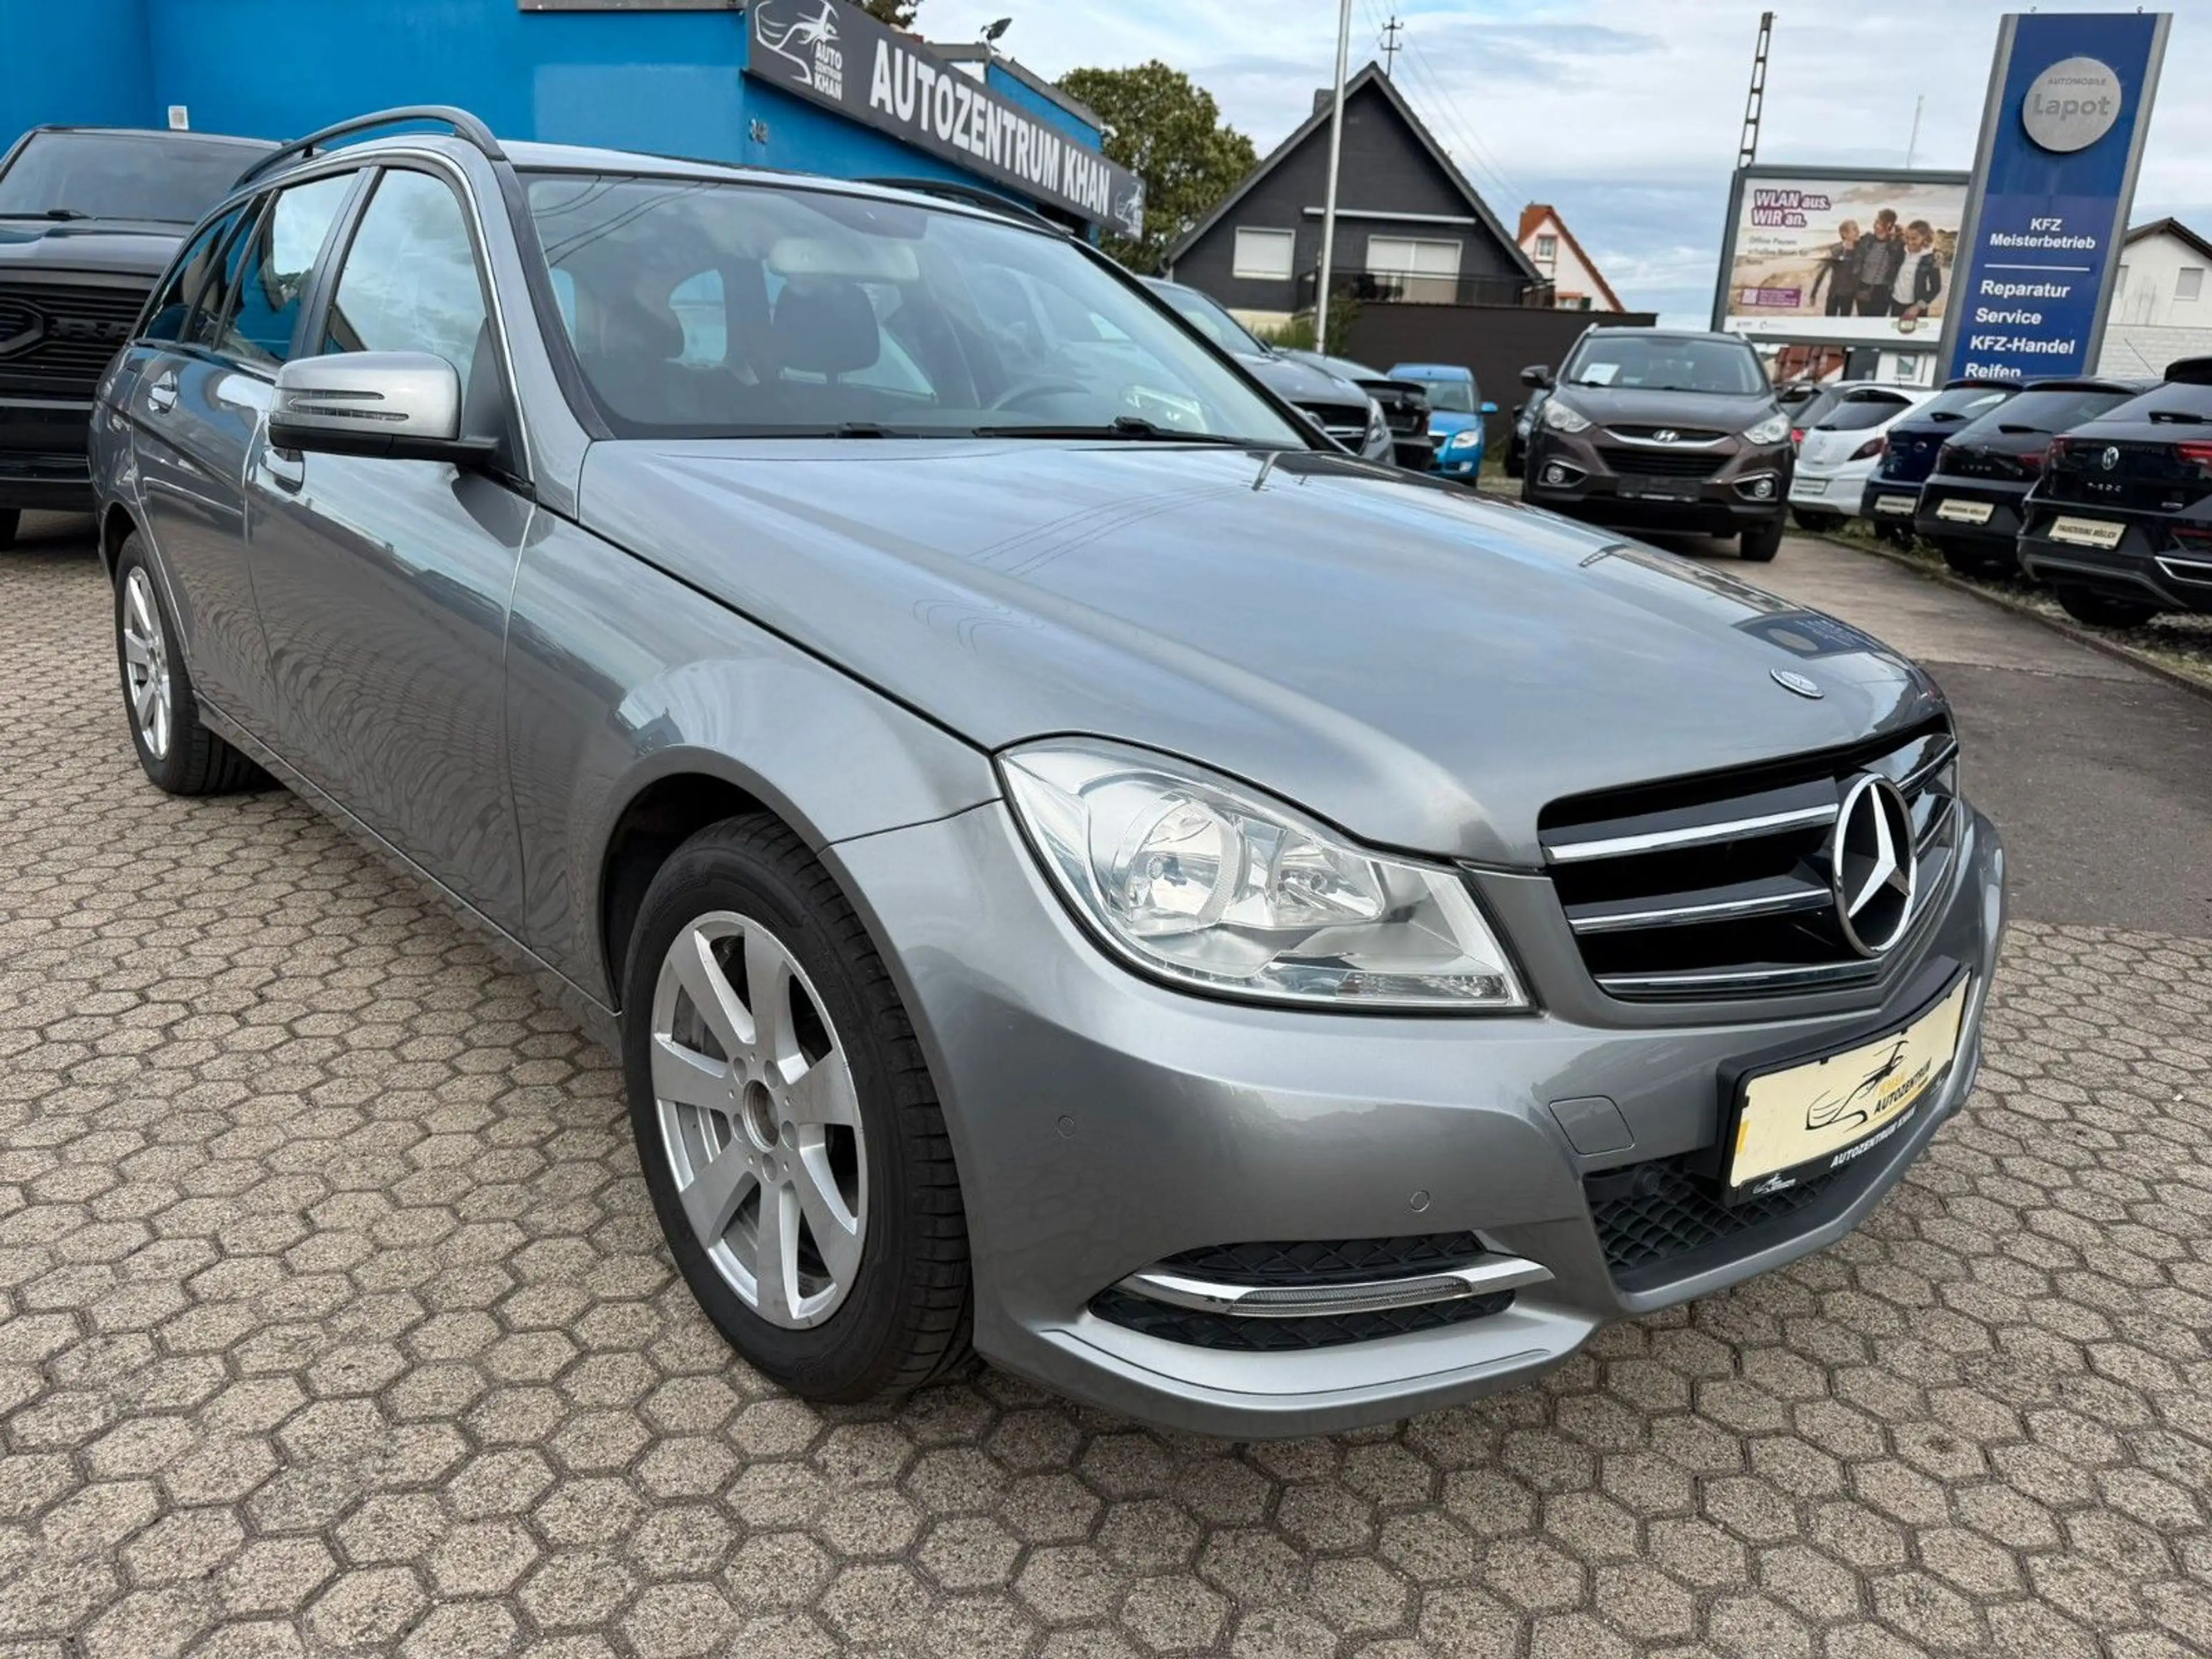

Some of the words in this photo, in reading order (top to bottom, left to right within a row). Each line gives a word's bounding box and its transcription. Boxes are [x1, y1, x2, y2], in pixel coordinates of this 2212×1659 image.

[815, 41, 842, 70] AUTO
[814, 72, 842, 102] KHAN
[2032, 93, 2111, 122] Lapot
[869, 38, 1060, 192] AUTOZENTRUM
[1062, 144, 1111, 217] KHAN
[1755, 190, 1800, 208] WLAN
[1801, 195, 1830, 210] aus.
[1753, 209, 1783, 225] WIR
[1784, 213, 1807, 226] an.
[2030, 218, 2063, 232] KFZ
[1990, 232, 2096, 249] Meisterbetrieb
[1980, 280, 2071, 298] Reparatur
[1975, 307, 2043, 325] Service
[1969, 334, 2076, 355] KFZ-Handel
[1964, 362, 2022, 378] Reifen
